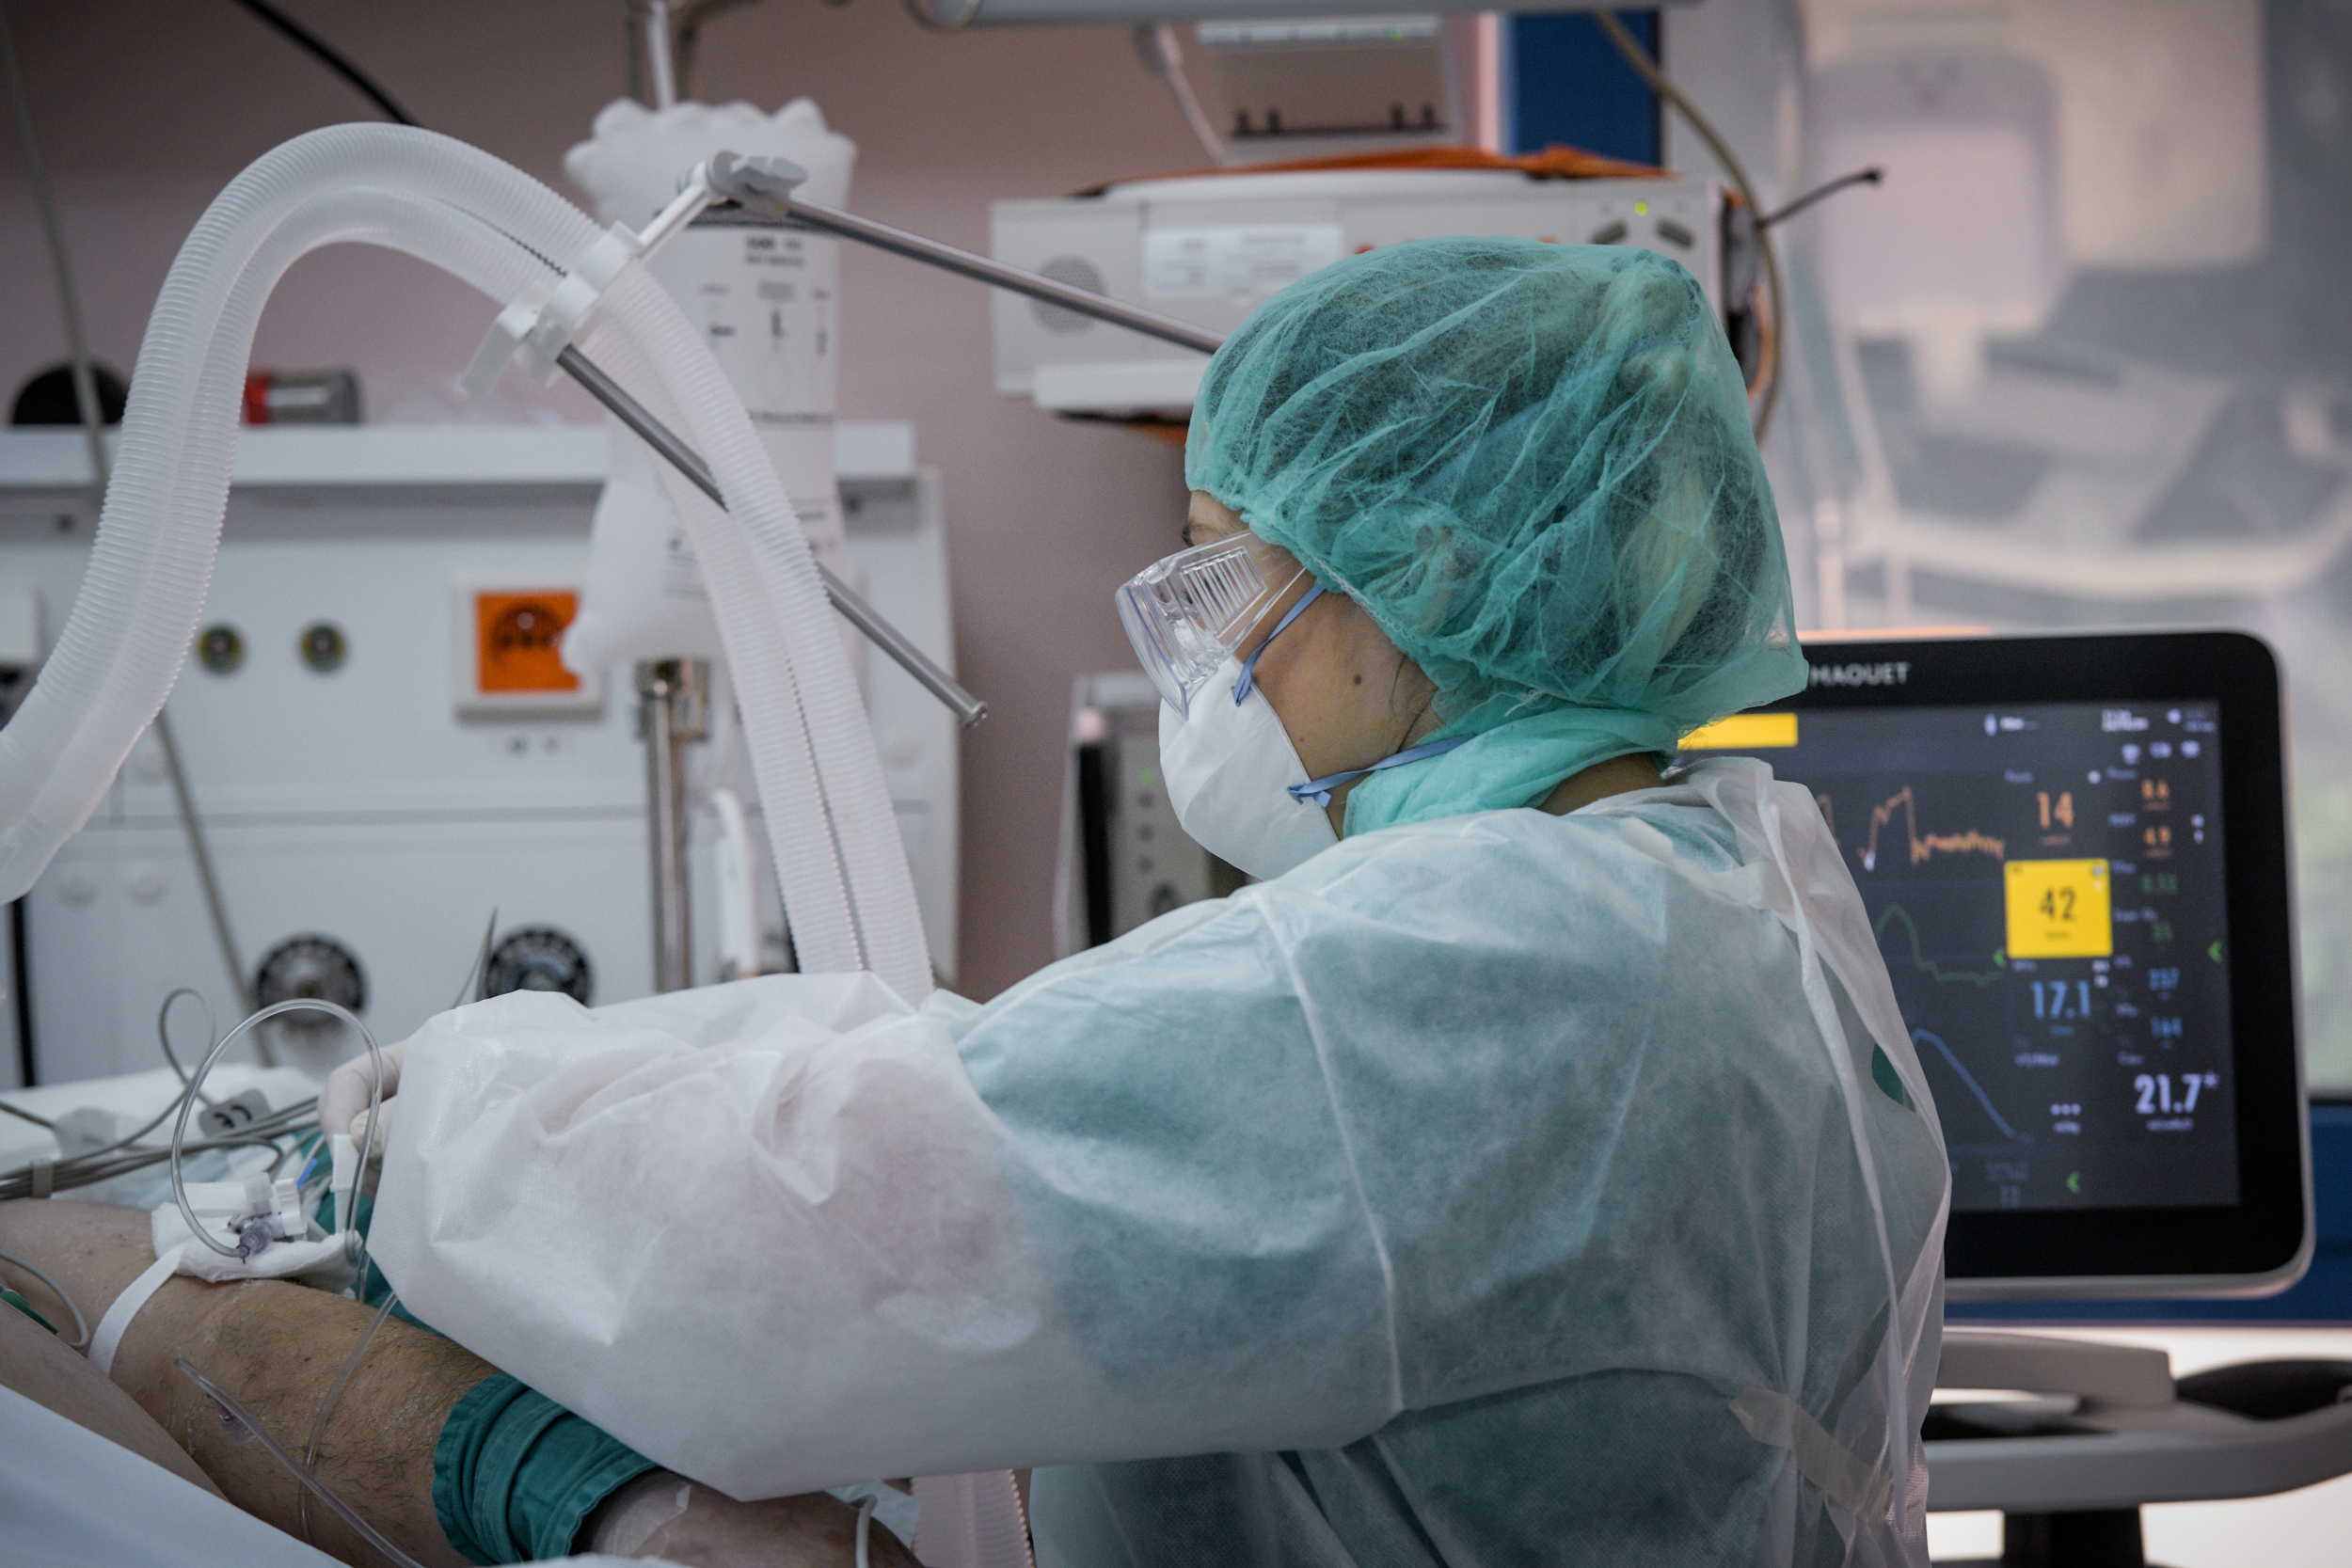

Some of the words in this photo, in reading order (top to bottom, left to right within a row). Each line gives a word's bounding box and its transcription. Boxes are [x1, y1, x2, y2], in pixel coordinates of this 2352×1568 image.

[1809, 660, 1911, 688] MAQUET
[2037, 791, 2074, 829] 14
[2039, 886, 2077, 923] 42
[2030, 979, 2091, 1020] 17.1
